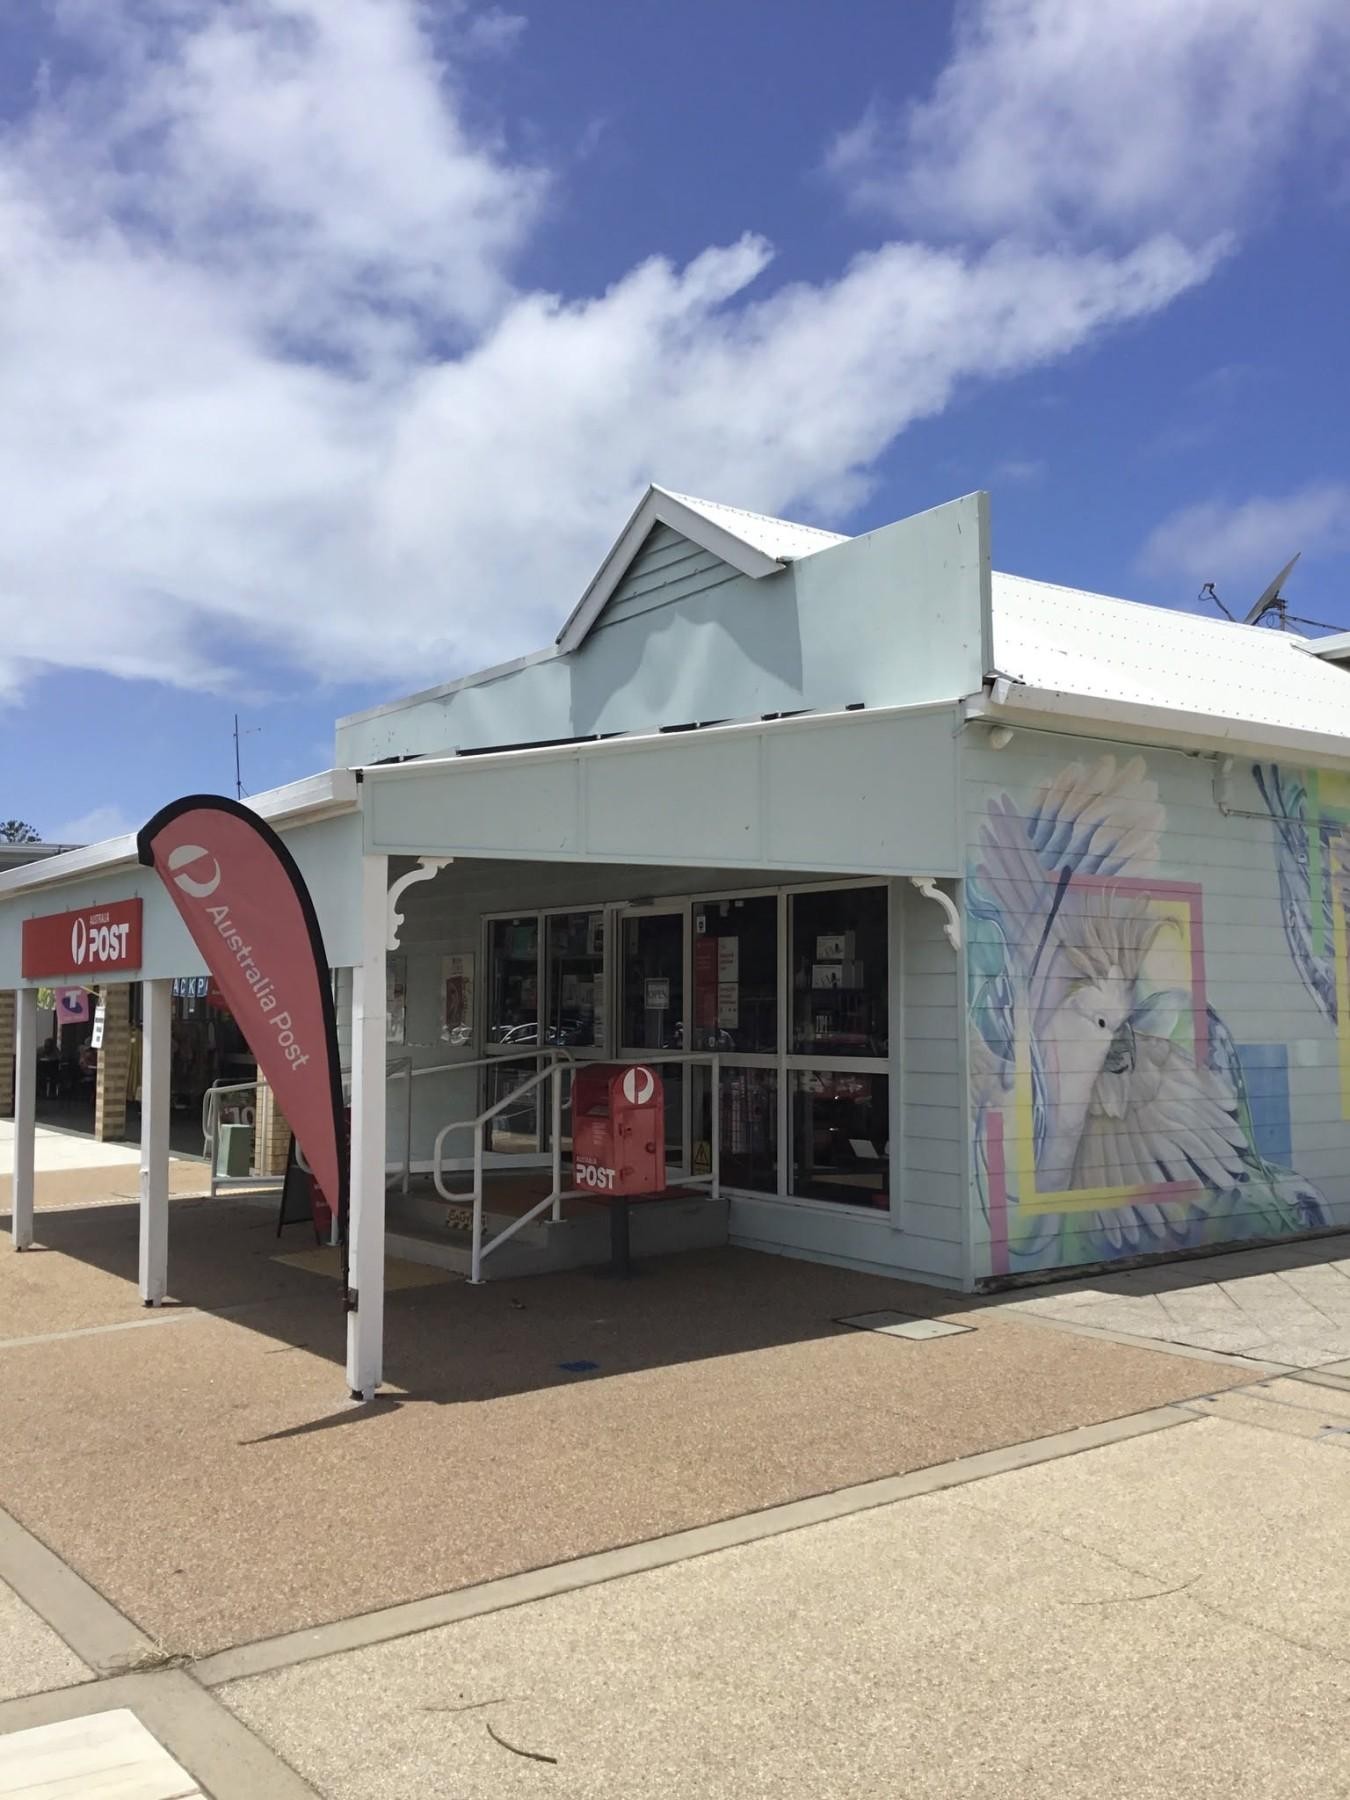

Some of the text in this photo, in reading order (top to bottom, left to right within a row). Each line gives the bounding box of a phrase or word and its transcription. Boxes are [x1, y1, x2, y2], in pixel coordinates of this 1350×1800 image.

[88, 923, 130, 962] POST
[173, 978, 208, 995] ACKP
[205, 904, 310, 1071] Australia Post
[576, 1163, 616, 1190] POST
